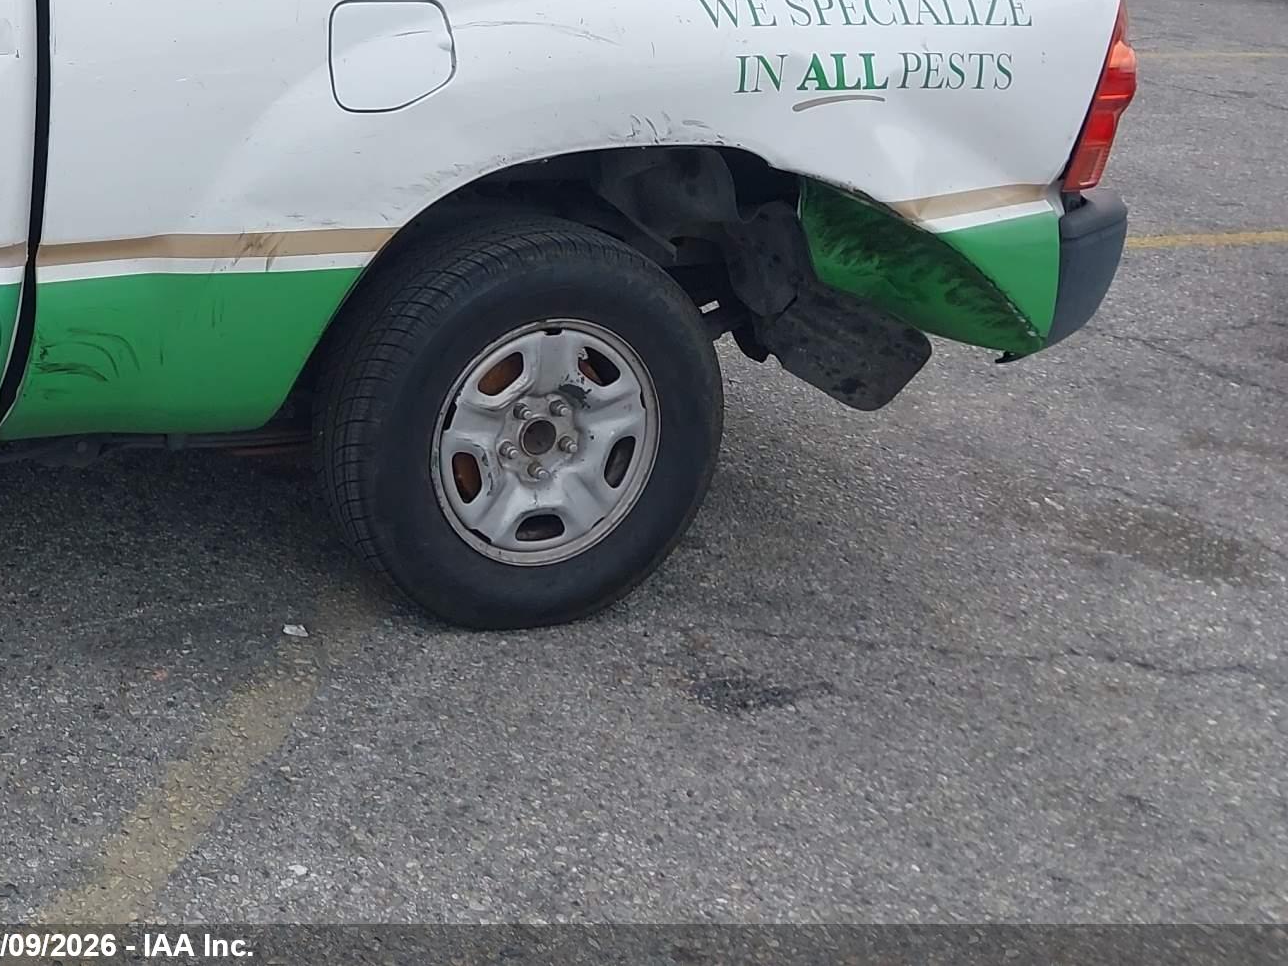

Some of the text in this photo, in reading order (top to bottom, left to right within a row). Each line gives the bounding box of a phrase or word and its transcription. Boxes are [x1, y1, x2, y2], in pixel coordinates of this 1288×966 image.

[733, 52, 1013, 94] IN ALL PESTS
